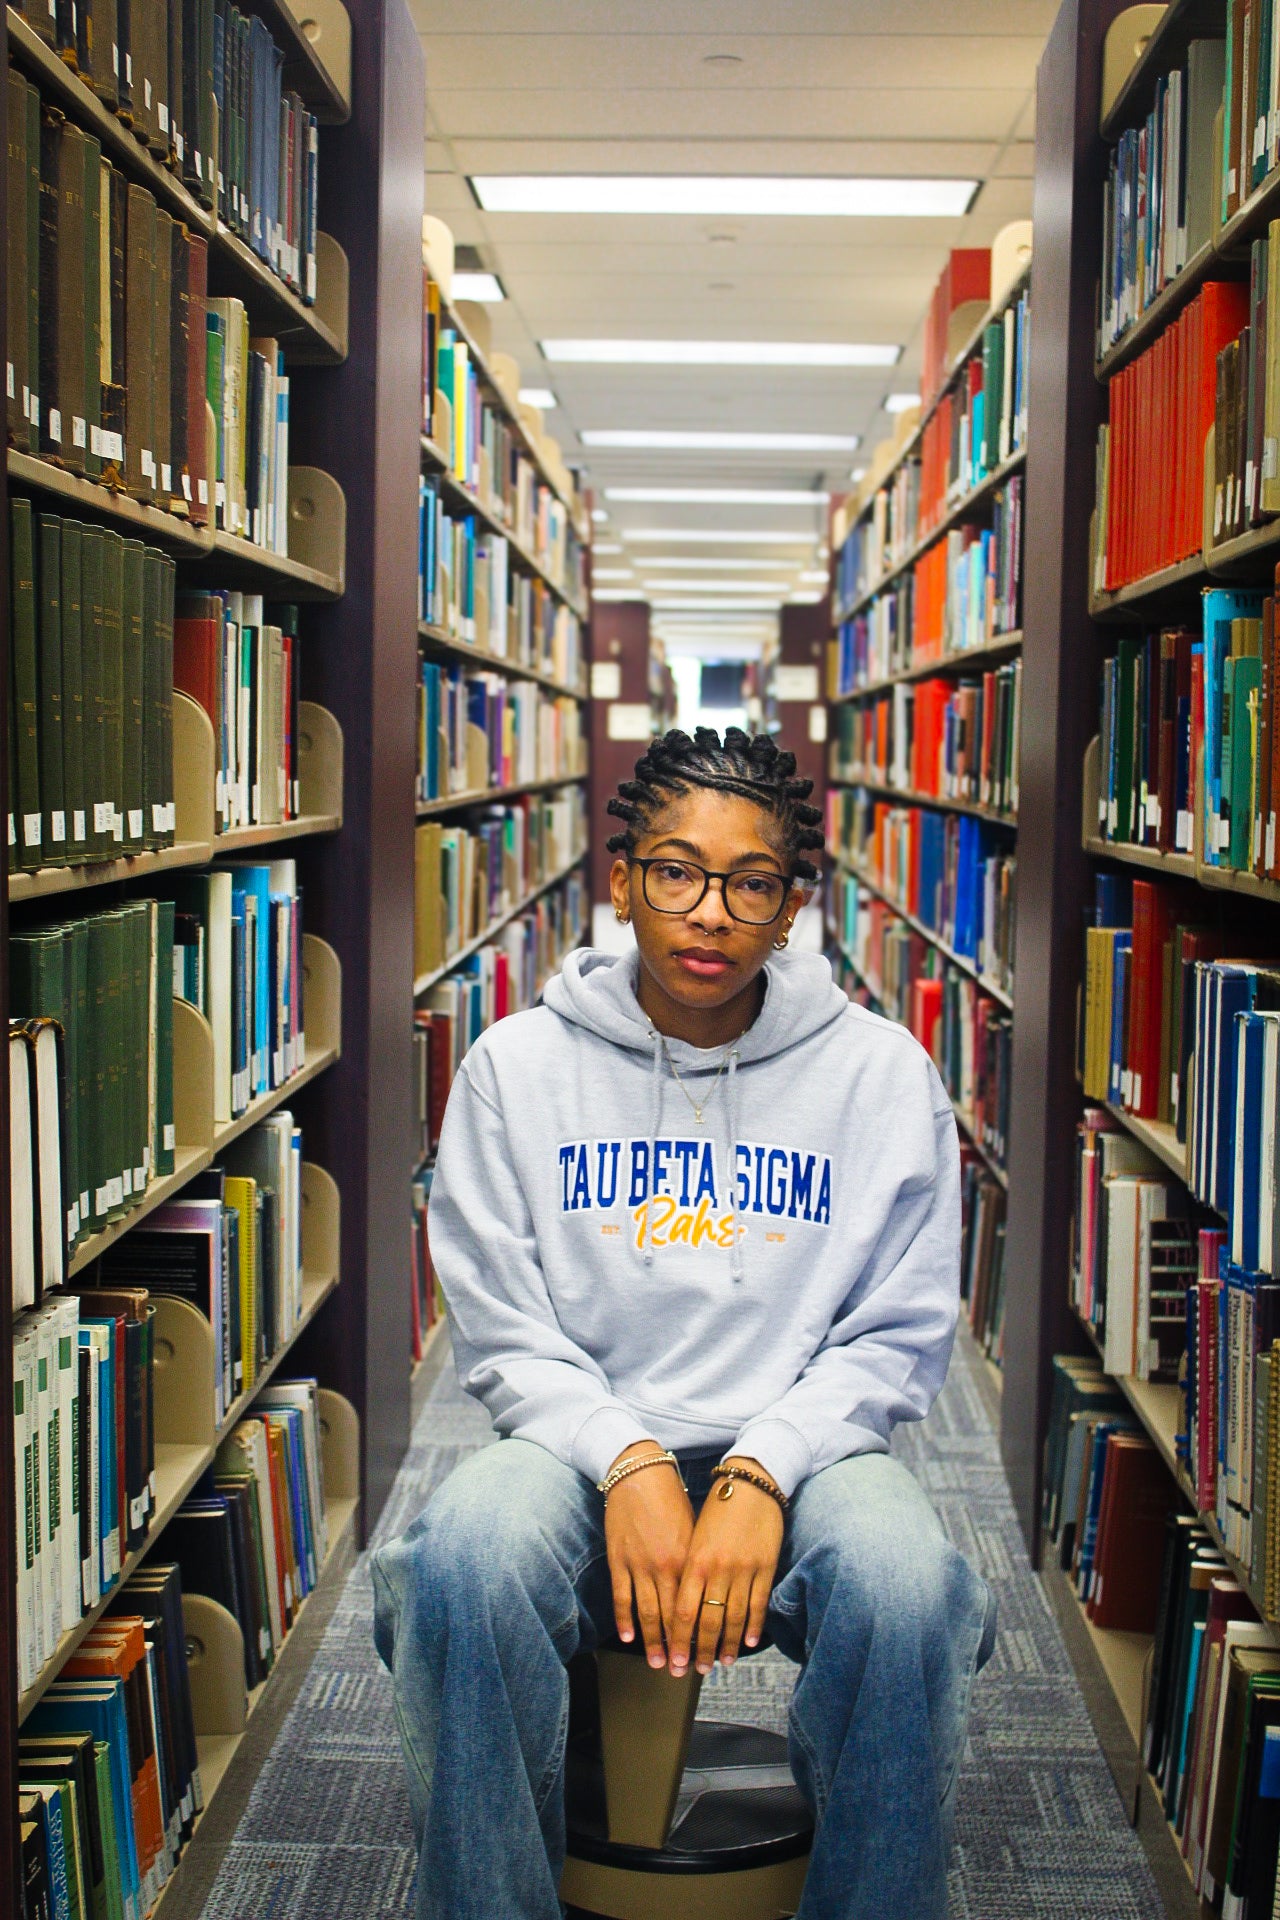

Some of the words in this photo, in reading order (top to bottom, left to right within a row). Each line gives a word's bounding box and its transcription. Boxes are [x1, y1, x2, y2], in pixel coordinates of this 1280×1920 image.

[559, 1142, 621, 1211] TAU
[628, 1140, 718, 1209] BETA
[730, 1144, 831, 1225] SIGMA
[1232, 1294, 1241, 1351] Physical
[1231, 1355, 1240, 1444] Examination
